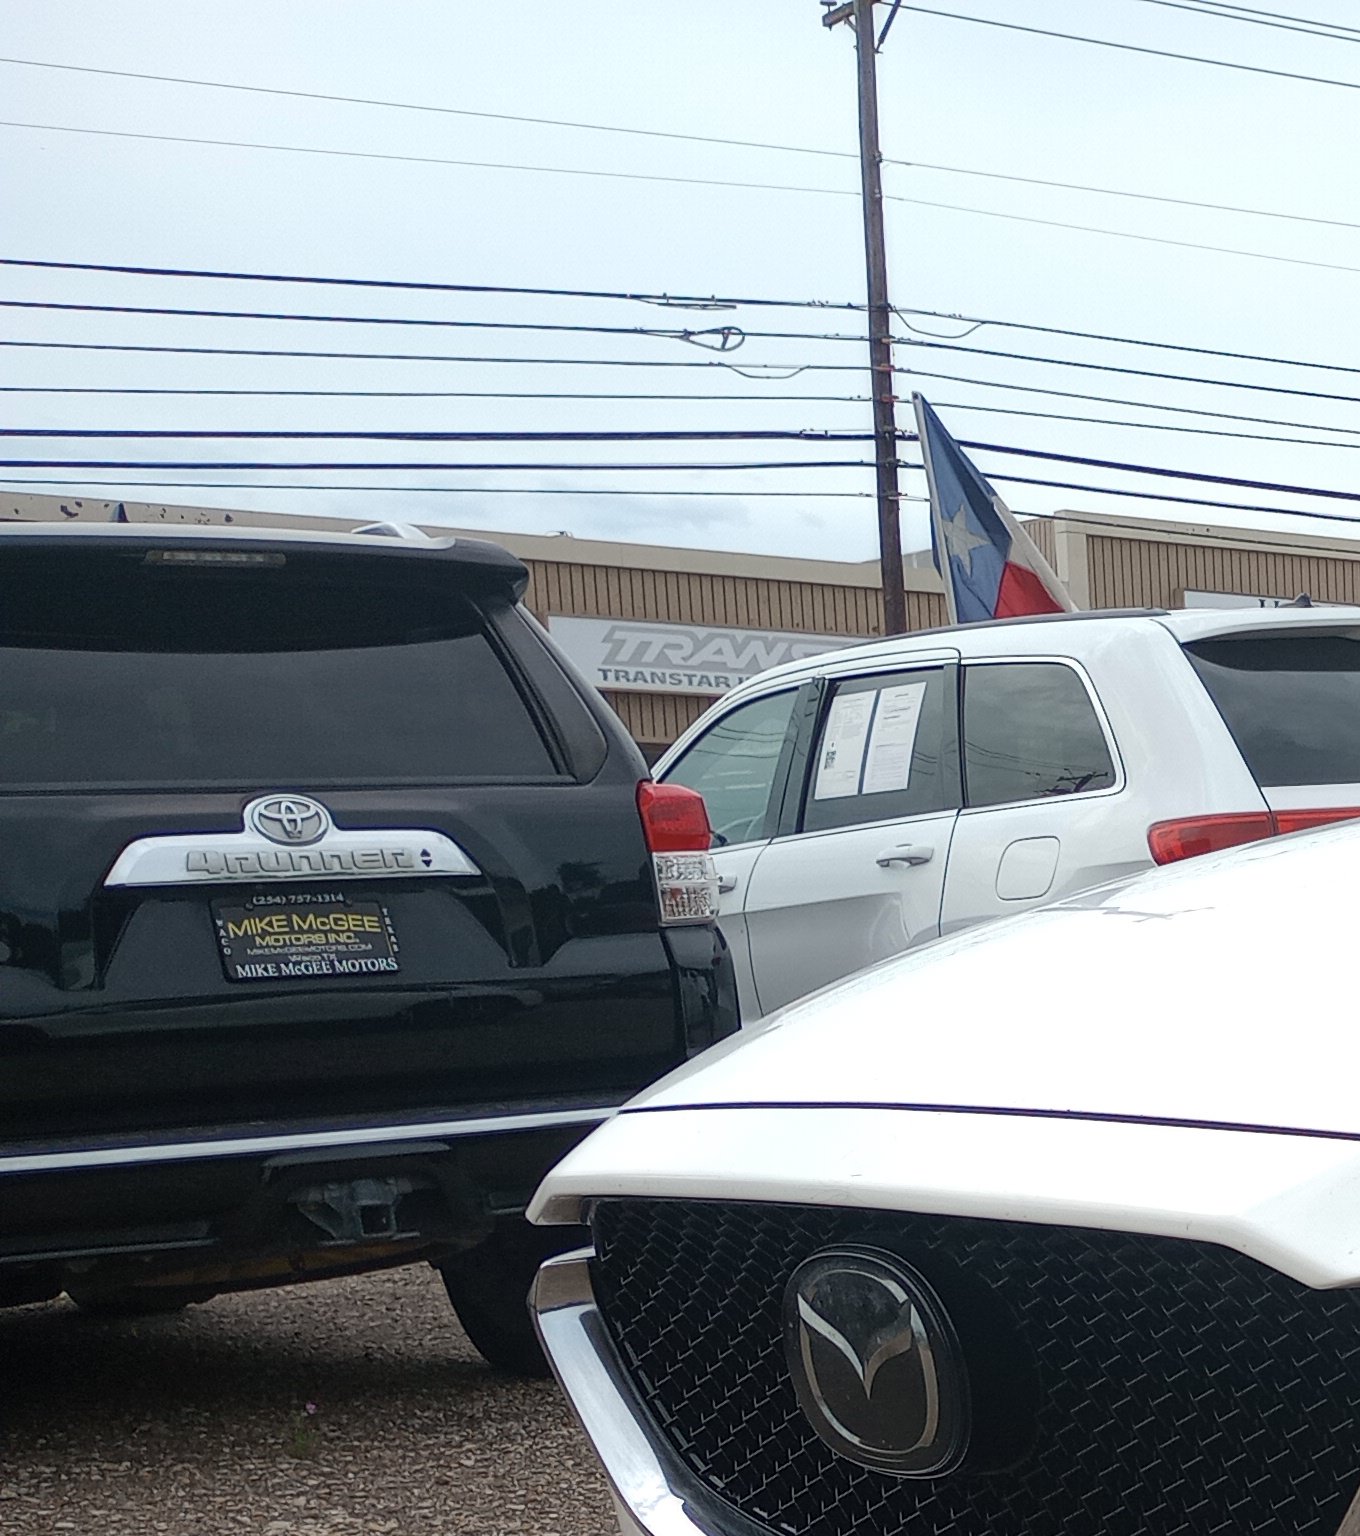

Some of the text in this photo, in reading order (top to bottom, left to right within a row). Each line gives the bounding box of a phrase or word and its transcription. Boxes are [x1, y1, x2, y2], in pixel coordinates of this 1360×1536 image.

[597, 668, 732, 689] TRANSTAR
[252, 895, 287, 905] (254)
[227, 913, 382, 938] MIKE McGEE
[215, 919, 232, 955] WACO
[255, 932, 360, 947] MOTORS INC.
[235, 957, 399, 978] MIKE McGEE MOTORS
